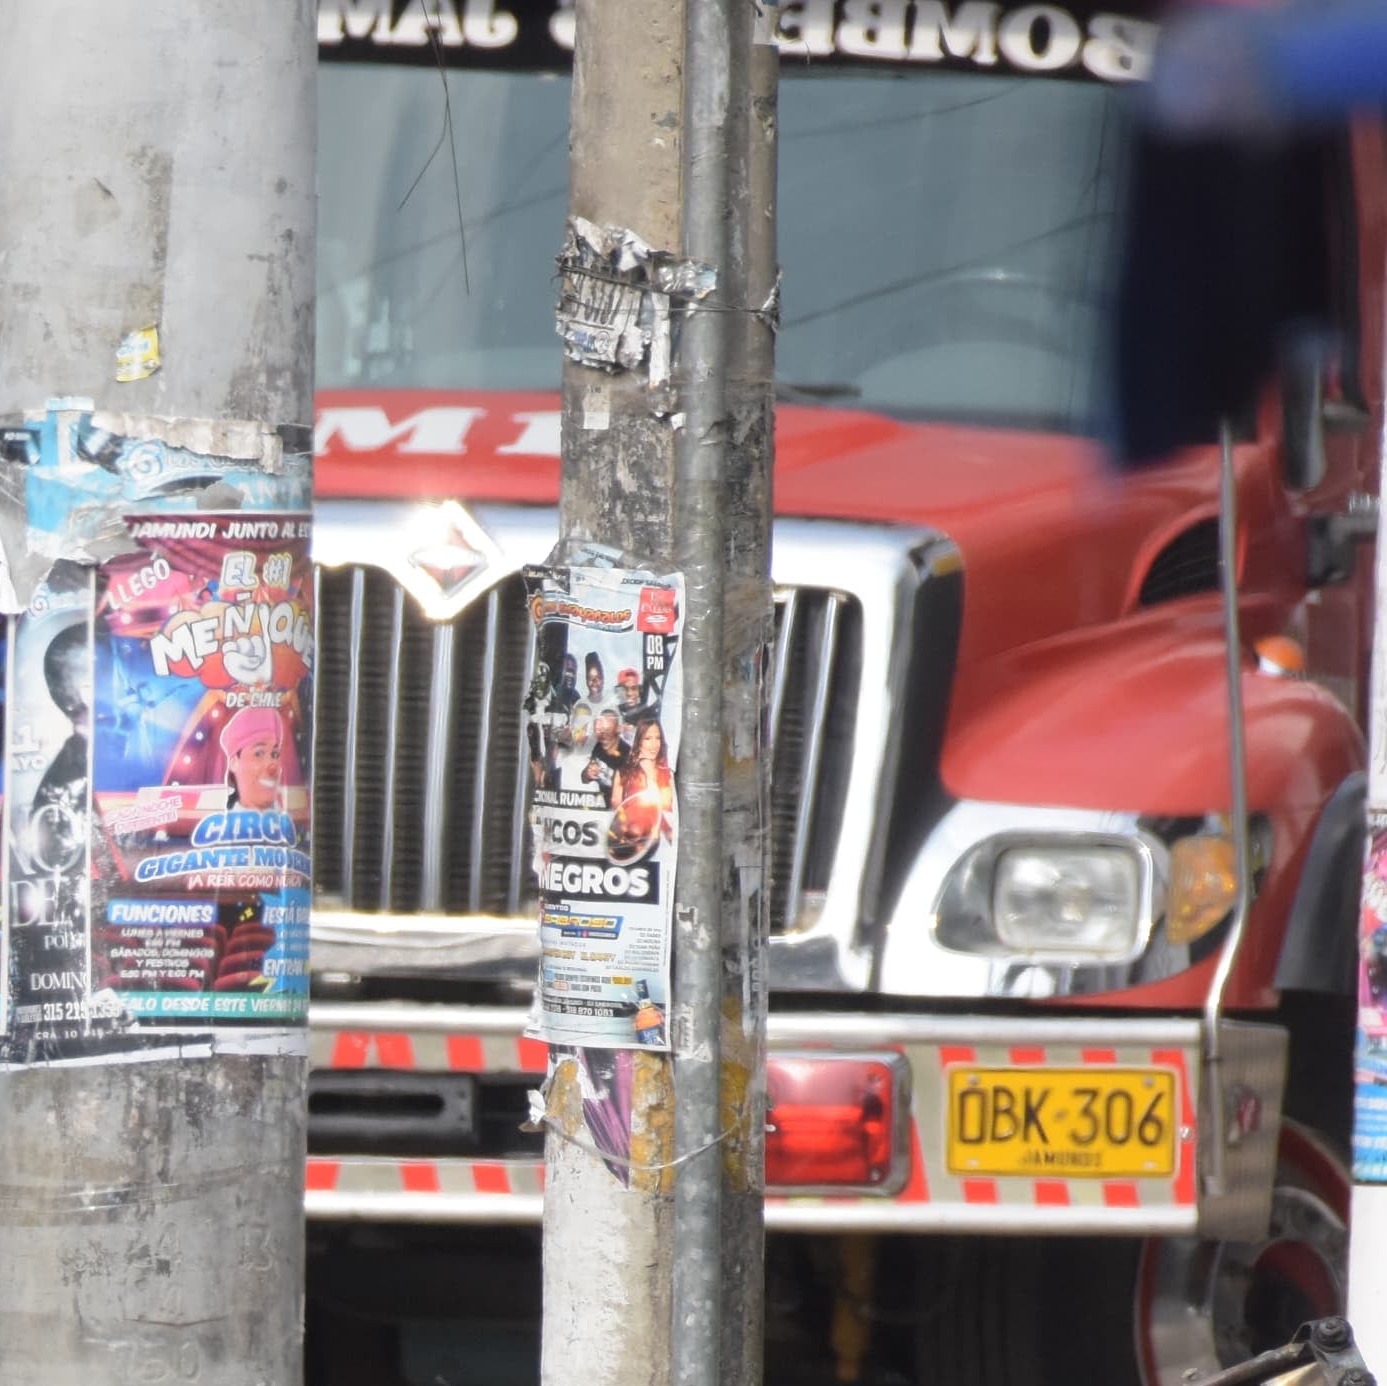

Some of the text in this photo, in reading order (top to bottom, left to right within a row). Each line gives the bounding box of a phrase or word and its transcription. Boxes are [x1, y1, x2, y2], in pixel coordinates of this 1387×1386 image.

[129, 522, 218, 540] JAMUNDI
[221, 521, 279, 539] JUNTO
[221, 552, 259, 588] EL
[106, 553, 171, 611] LLEGÓ
[646, 634, 663, 655] 08
[646, 656, 664, 670] PM
[226, 692, 243, 708] DE
[559, 791, 606, 808] RUMBA
[135, 846, 250, 882] GIGANTE
[238, 873, 273, 888] COMO
[539, 861, 650, 898] NEGROS
[110, 903, 214, 923] FUNCIONES
[43, 1002, 64, 1022] 315
[161, 997, 210, 1012] DESDE
[213, 997, 246, 1012] ESTE
[957, 1085, 1165, 1147] OBK 306
